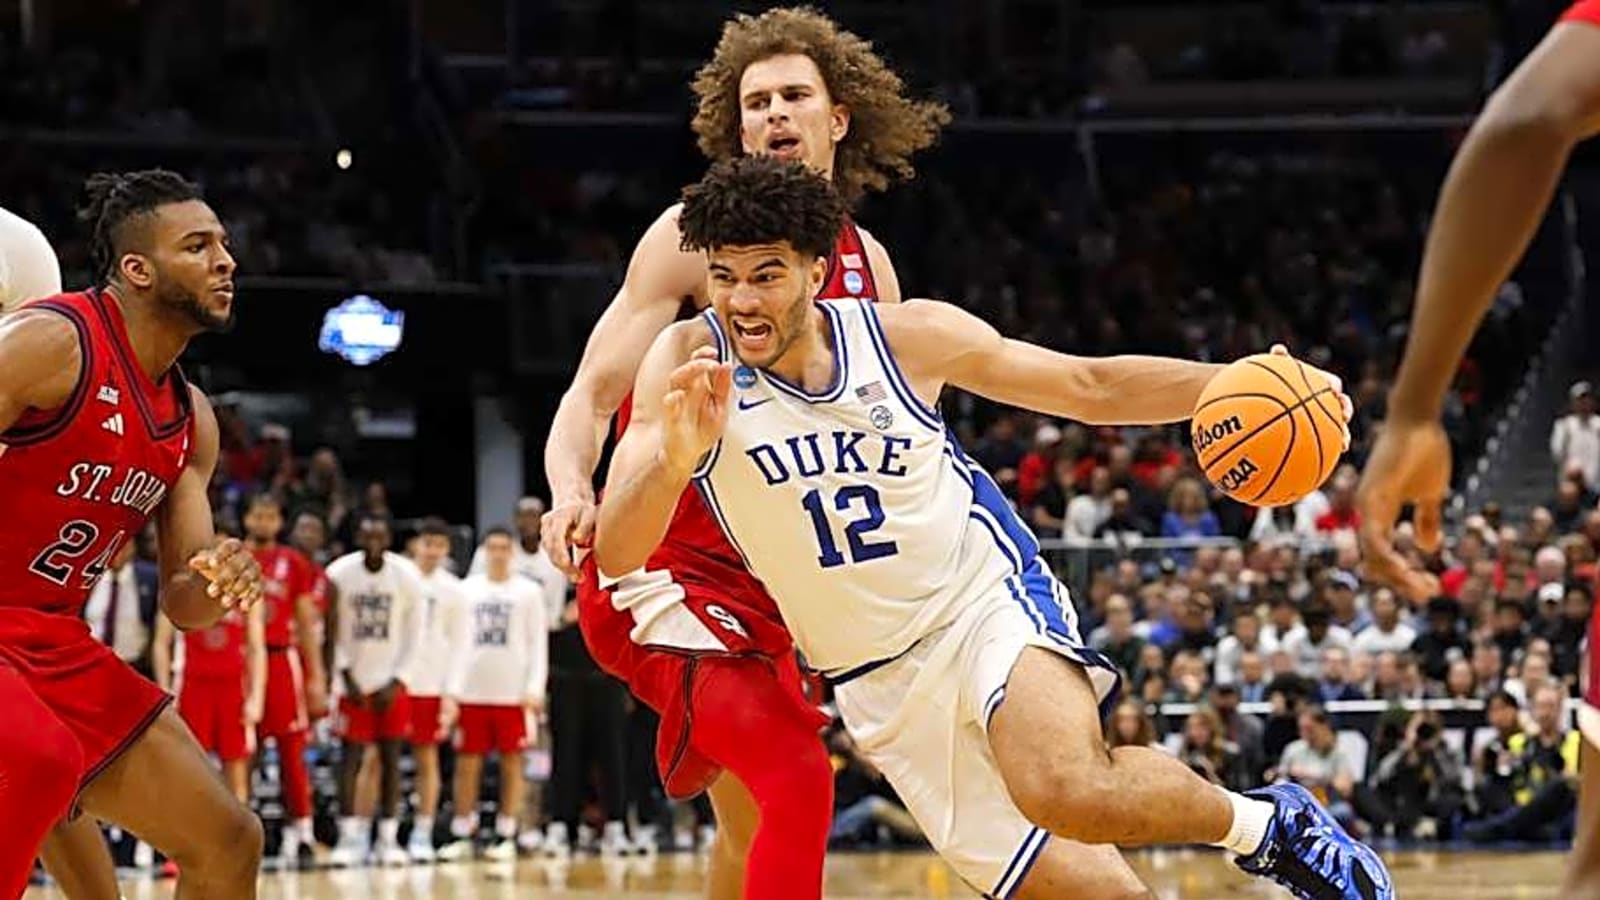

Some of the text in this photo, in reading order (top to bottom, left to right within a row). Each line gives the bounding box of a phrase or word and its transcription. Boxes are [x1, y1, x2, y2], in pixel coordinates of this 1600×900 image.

[57, 462, 112, 500] ST.
[745, 431, 912, 486] DUKE
[1219, 458, 1258, 491] CAA
[28, 519, 125, 589] 24
[801, 484, 899, 569] 12
